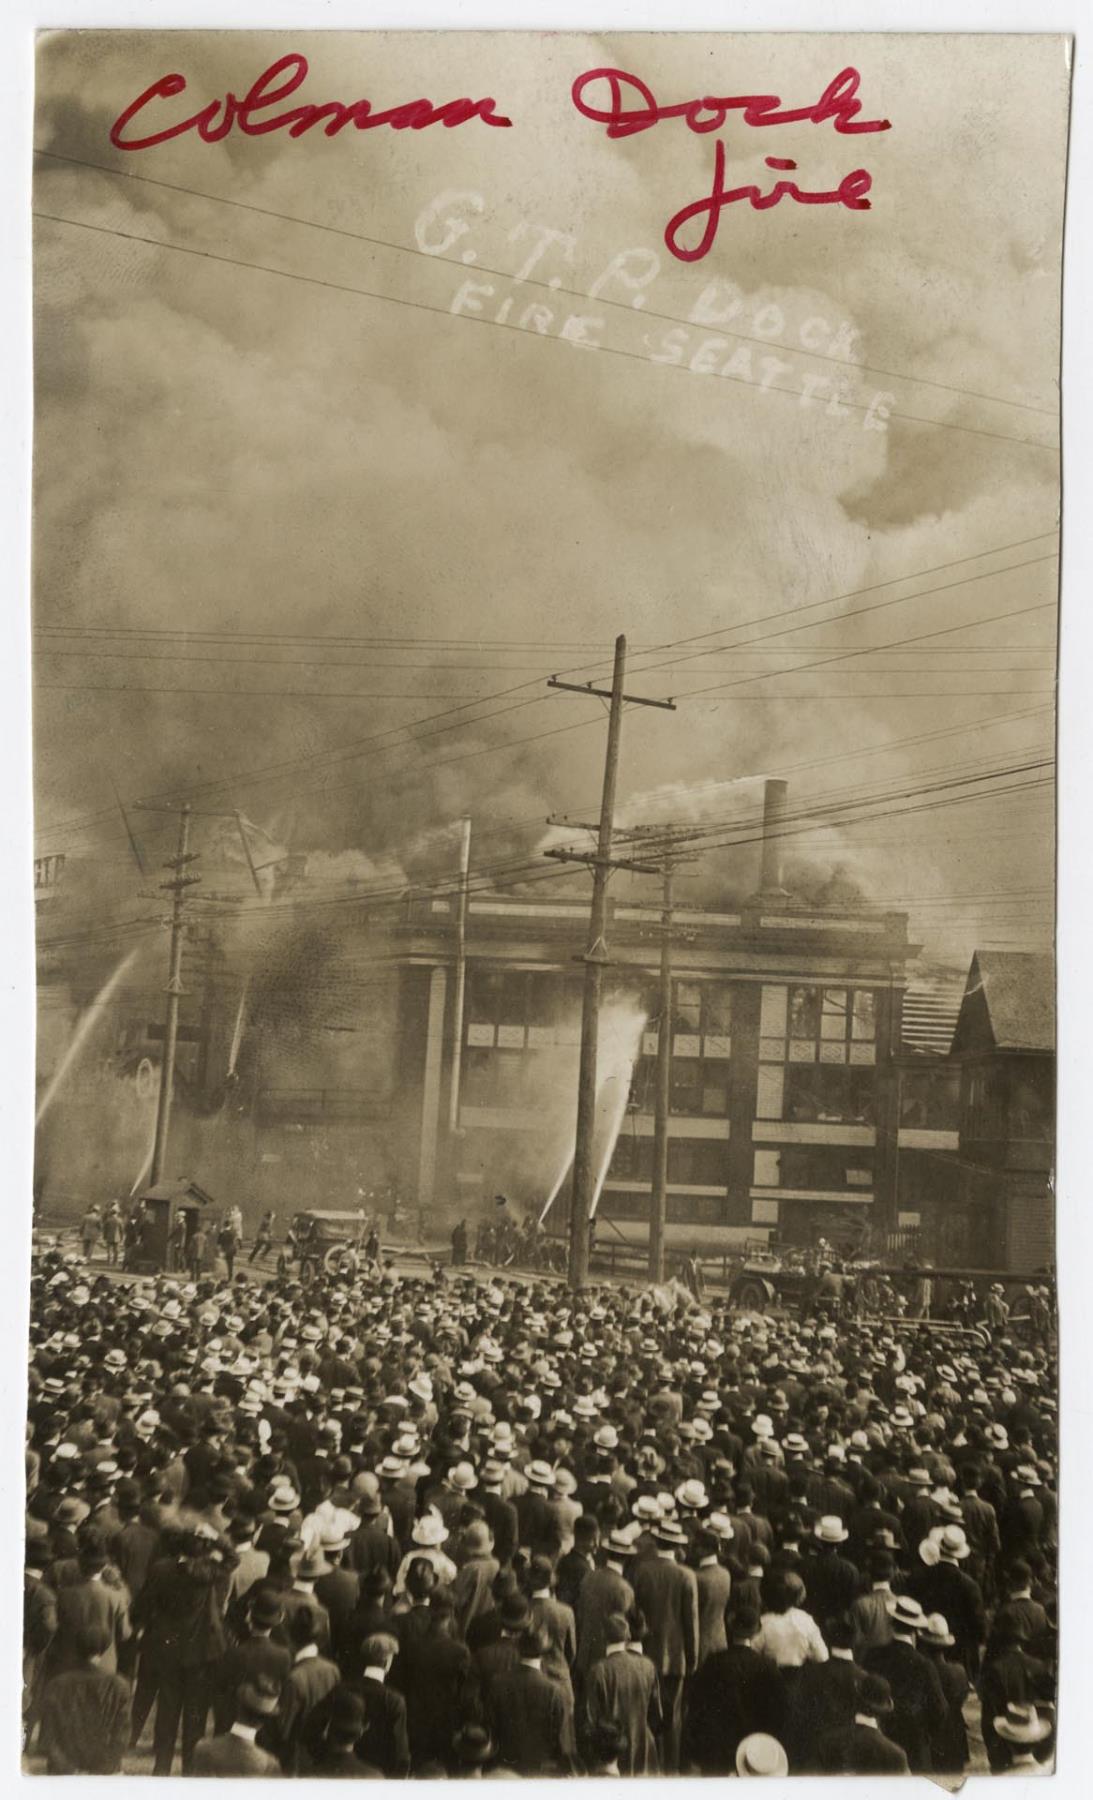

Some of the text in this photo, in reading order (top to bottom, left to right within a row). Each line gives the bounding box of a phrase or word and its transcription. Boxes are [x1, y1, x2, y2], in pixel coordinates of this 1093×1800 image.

[111, 52, 891, 150] Colman Dock
[663, 139, 872, 261] Fire
